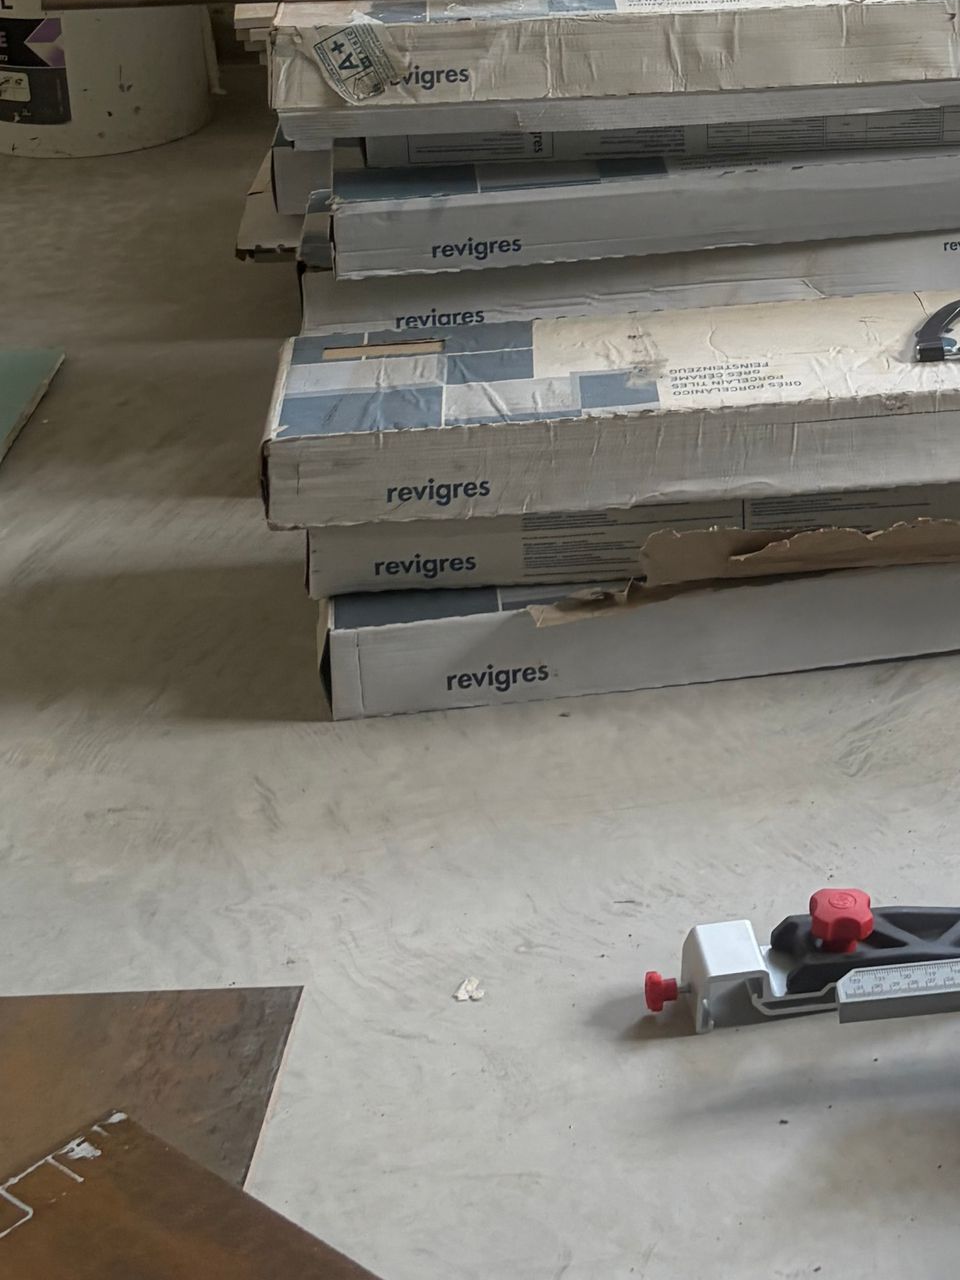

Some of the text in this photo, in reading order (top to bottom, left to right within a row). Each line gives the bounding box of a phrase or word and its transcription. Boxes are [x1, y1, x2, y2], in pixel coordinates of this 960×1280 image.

[330, 39, 361, 71] A+
[390, 65, 469, 90] vigres
[431, 234, 522, 260] revigres
[669, 361, 769, 375] FEINSTEINZEUG
[671, 375, 784, 390] PORCELAIN TILES
[386, 477, 490, 506] revigres
[374, 553, 476, 579] revigres
[446, 664, 549, 693] revigres
